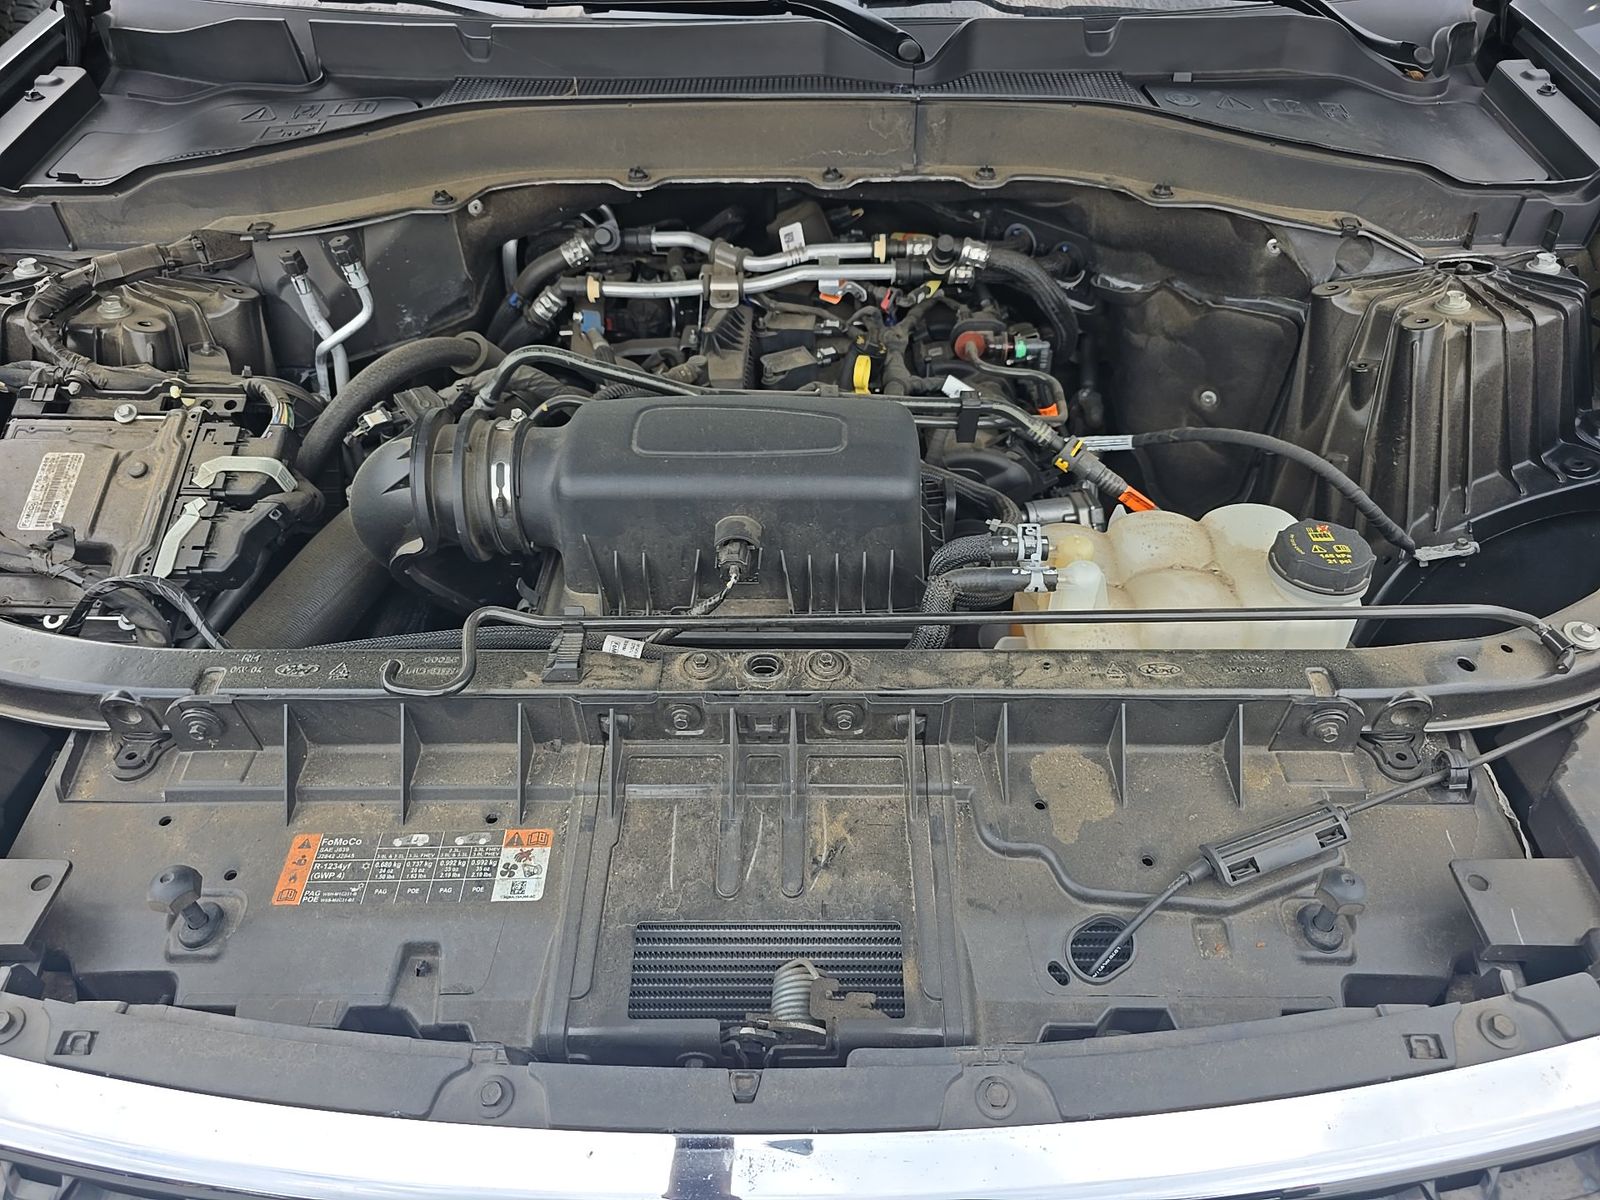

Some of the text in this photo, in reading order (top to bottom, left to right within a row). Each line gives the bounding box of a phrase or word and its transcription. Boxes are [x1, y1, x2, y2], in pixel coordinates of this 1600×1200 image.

[1143, 663, 1179, 675] Ford
[321, 837, 362, 846] FoMoCo
[314, 862, 352, 871] R-1234yf
[424, 861, 433, 869] kg
[310, 872, 345, 880] (GWP 4)
